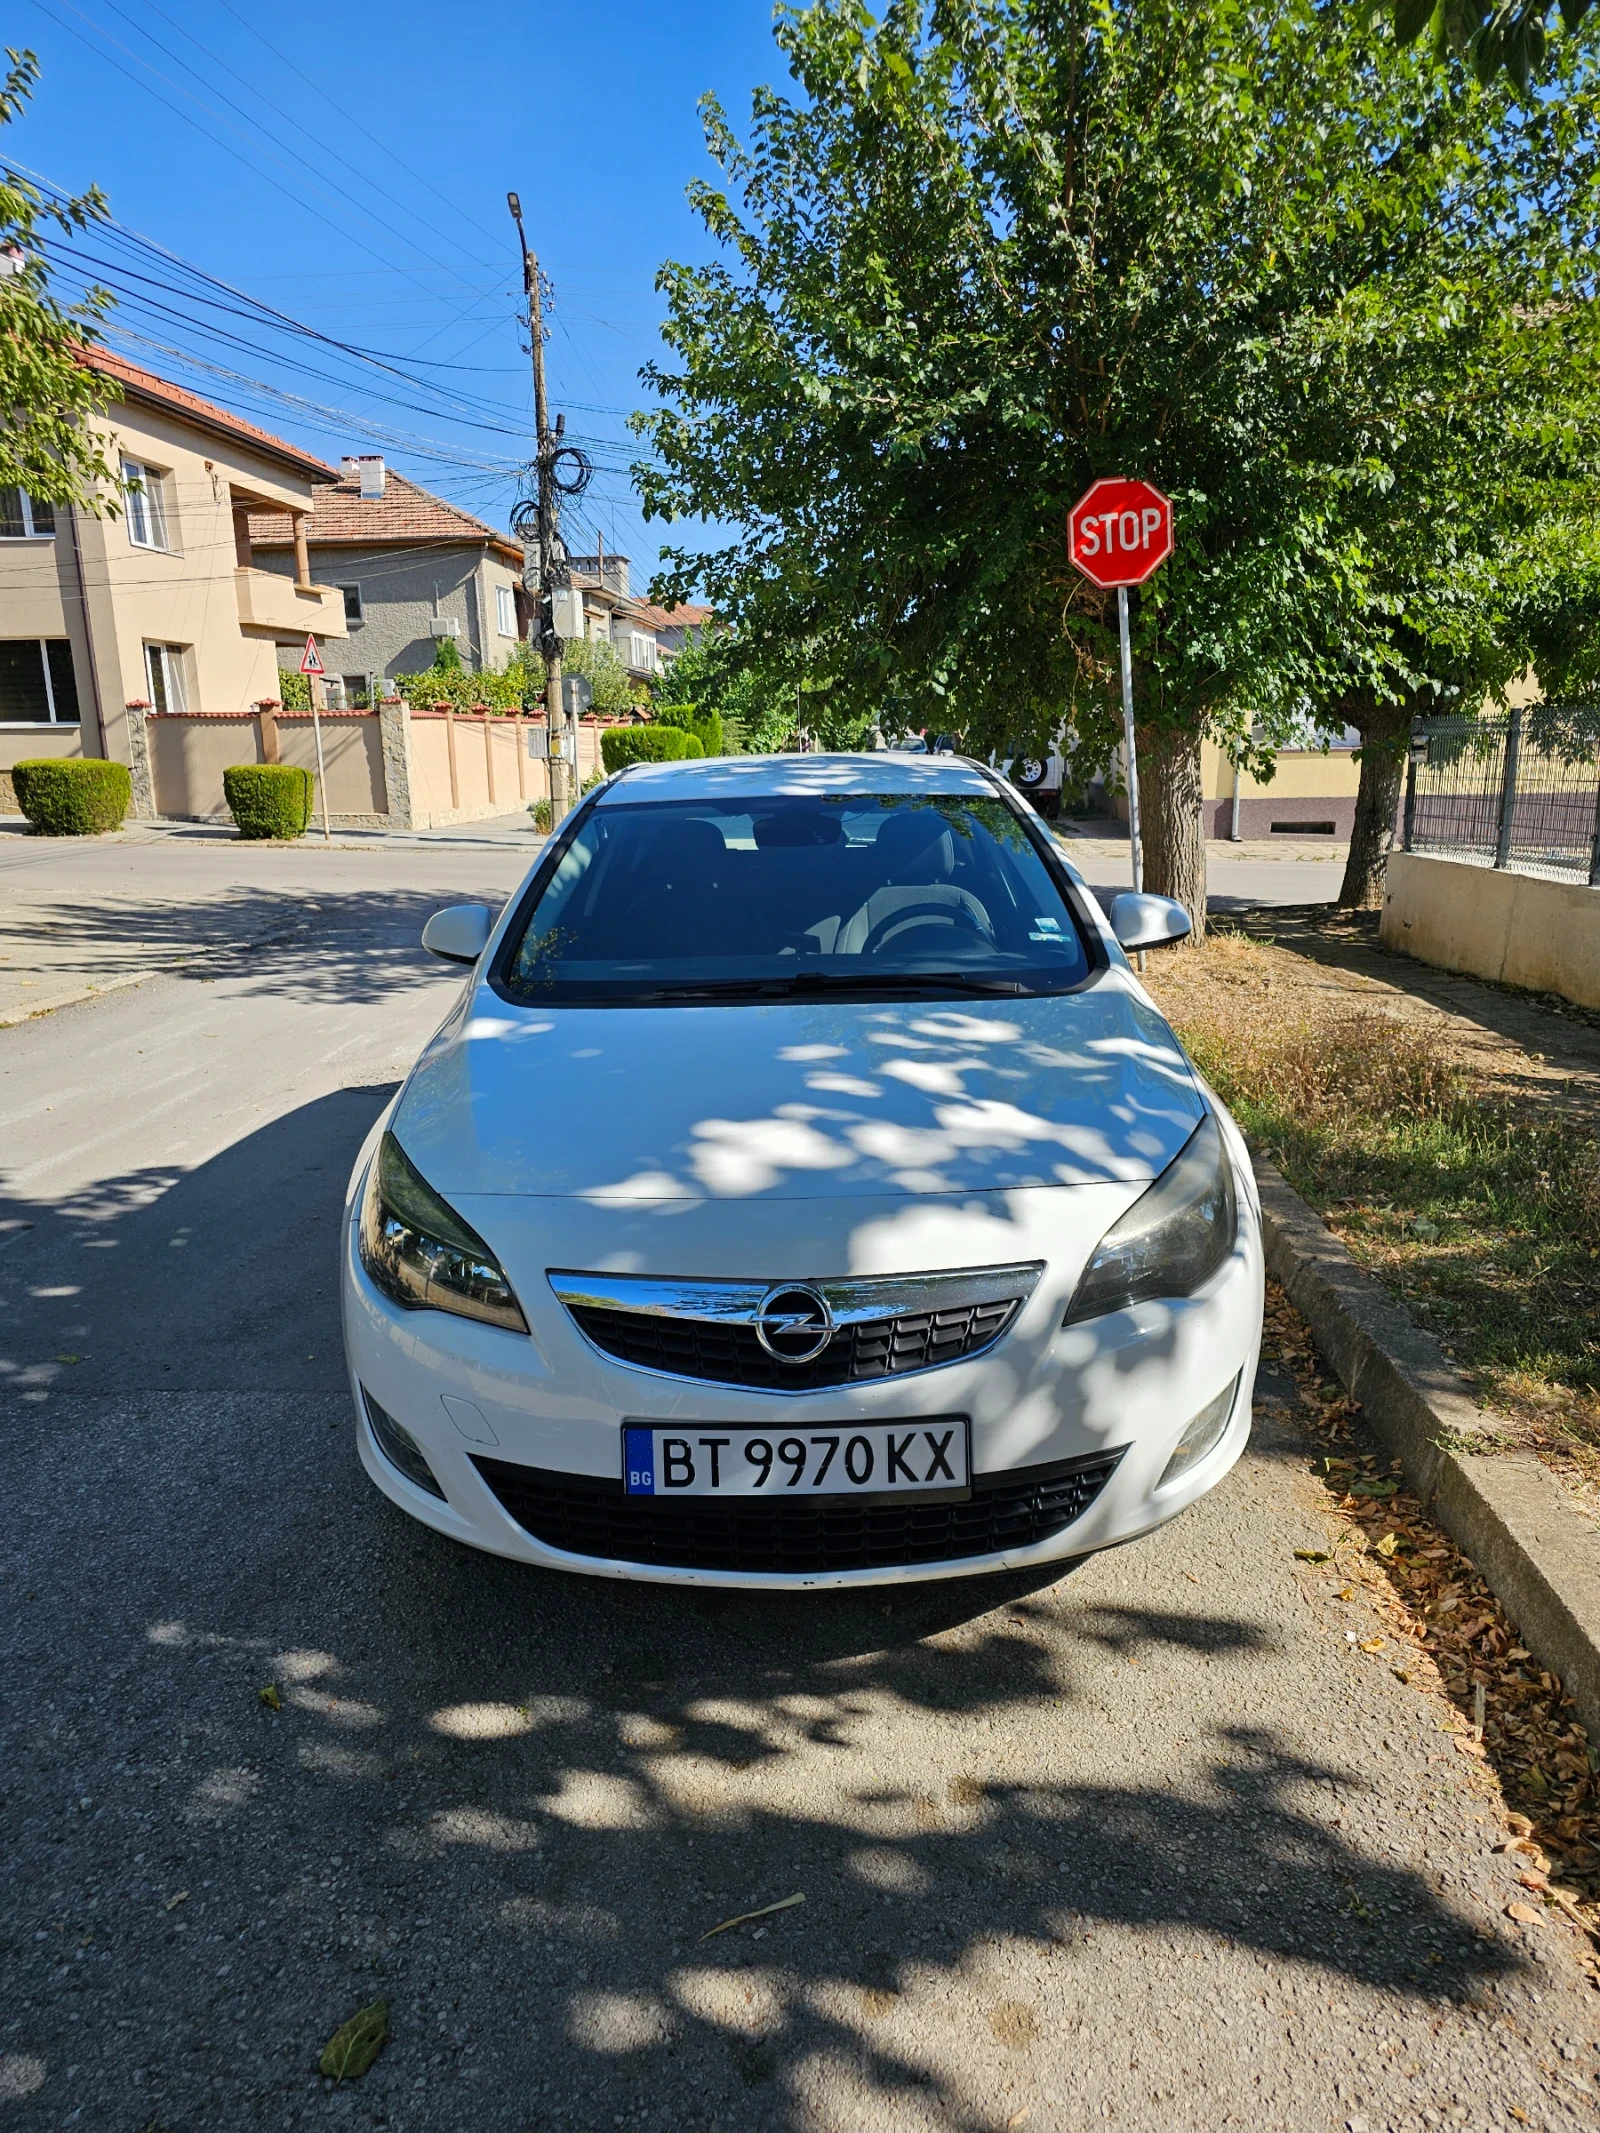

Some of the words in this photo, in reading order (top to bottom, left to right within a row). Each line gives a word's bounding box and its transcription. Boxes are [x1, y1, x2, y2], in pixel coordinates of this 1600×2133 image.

[1080, 508, 1161, 556] STOP
[630, 1471, 652, 1486] BG
[663, 1438, 730, 1488] BT
[744, 1435, 874, 1487] 9970
[887, 1430, 956, 1484] KX
